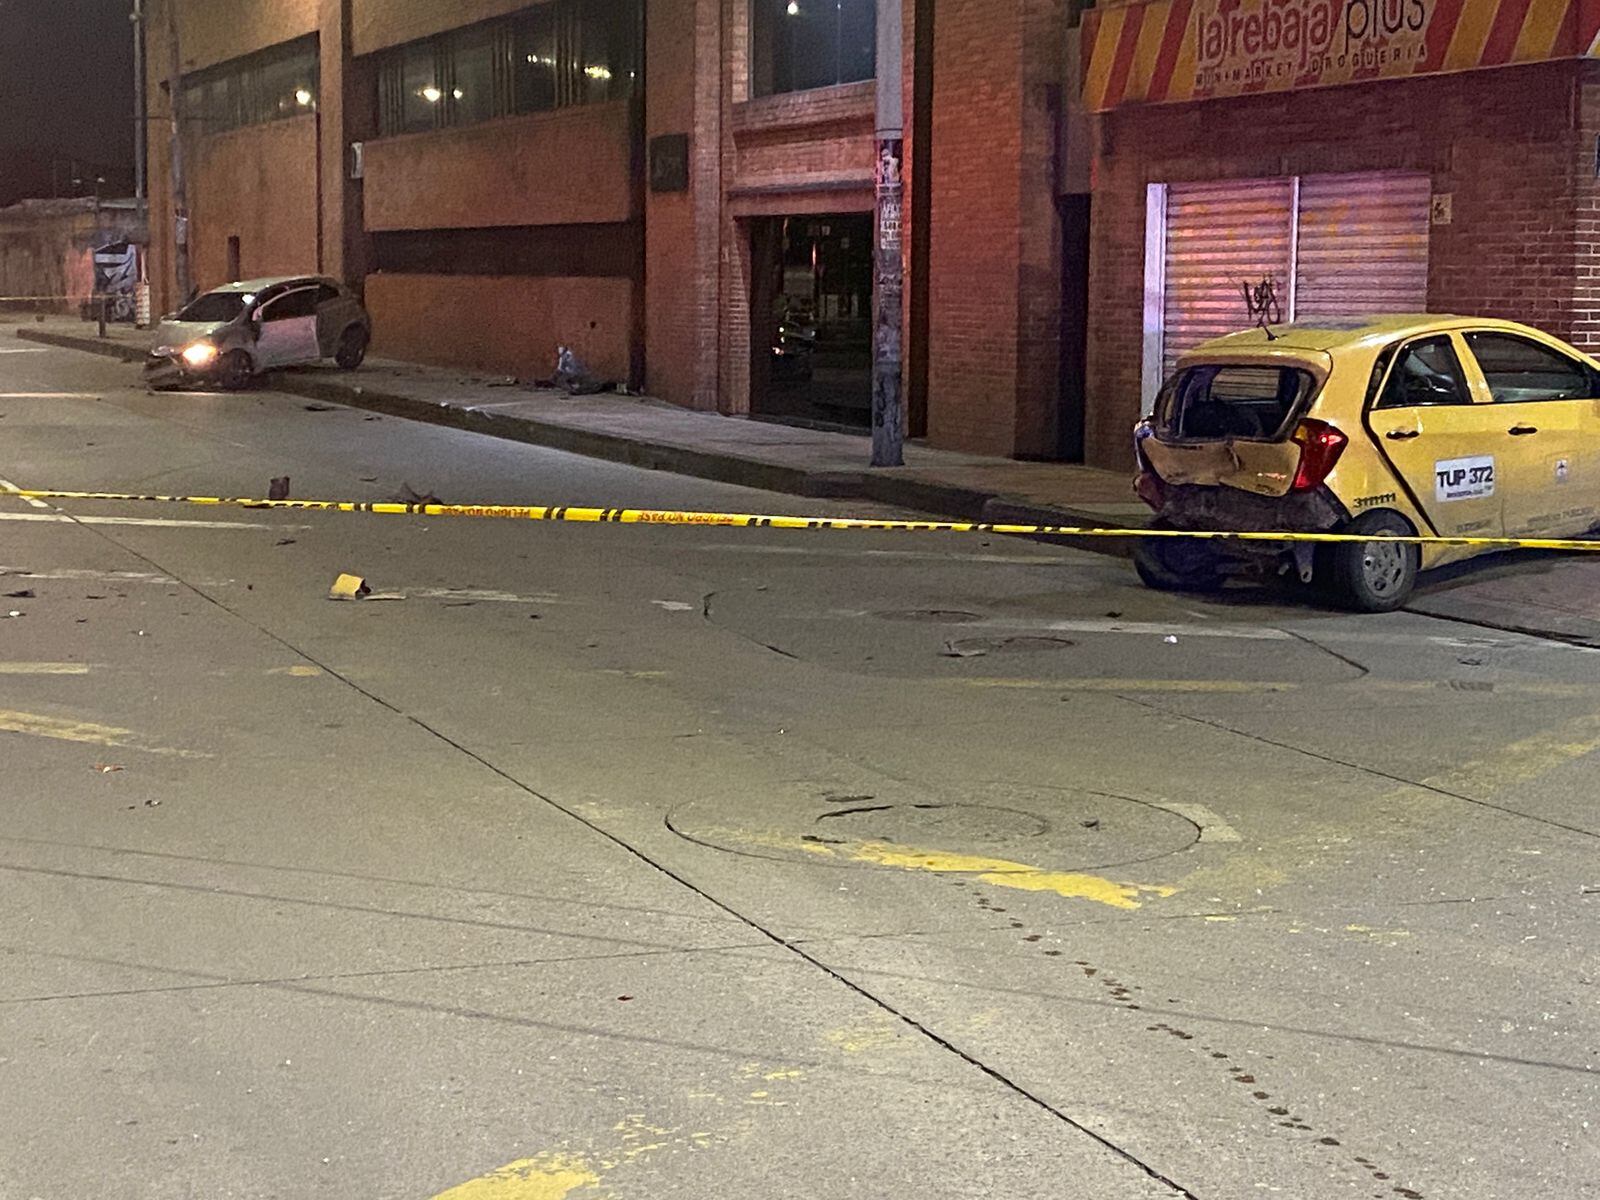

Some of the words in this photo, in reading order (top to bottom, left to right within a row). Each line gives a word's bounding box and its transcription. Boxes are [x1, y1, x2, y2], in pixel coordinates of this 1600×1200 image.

[1345, 0, 1425, 53] plus
[1437, 469, 1466, 488] TUP
[1469, 465, 1493, 484] 372
